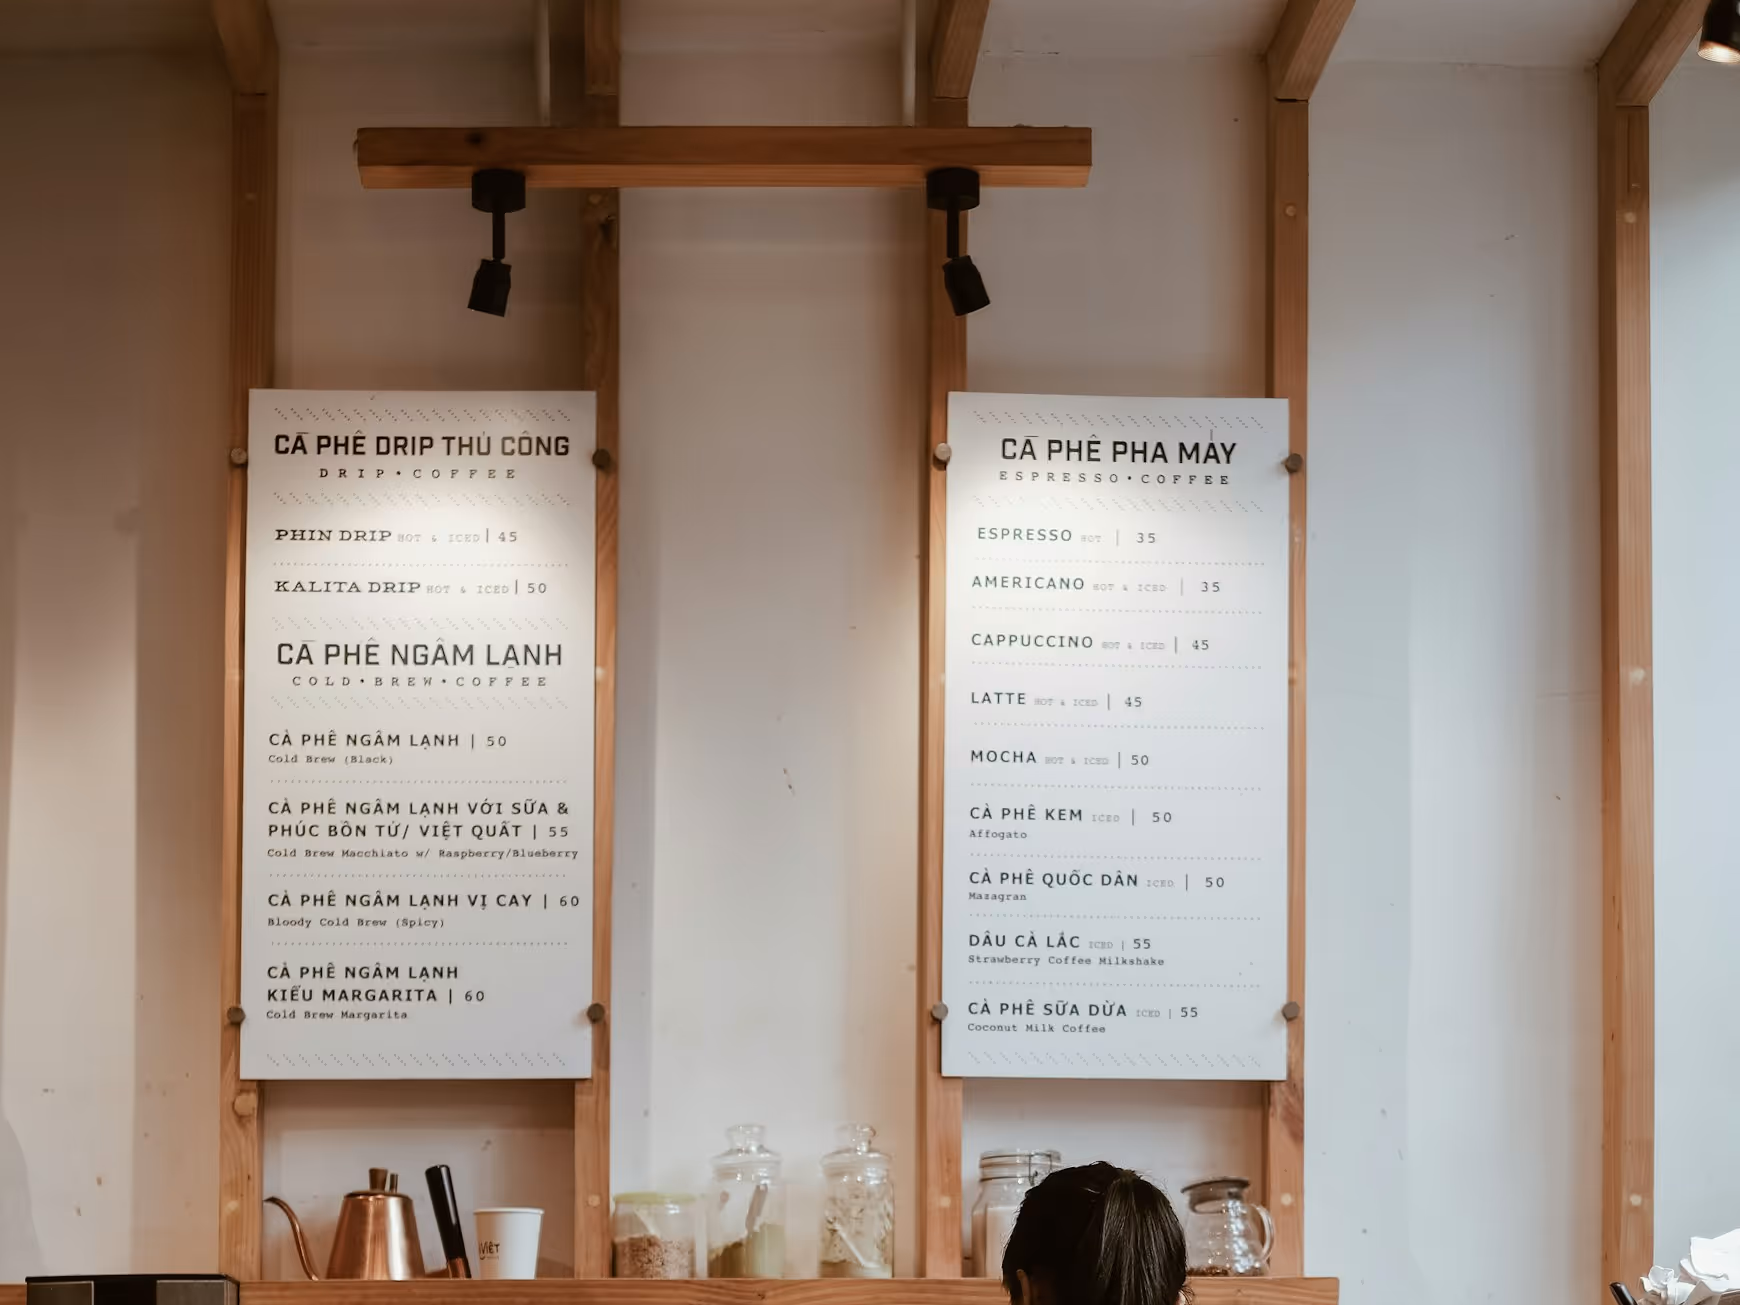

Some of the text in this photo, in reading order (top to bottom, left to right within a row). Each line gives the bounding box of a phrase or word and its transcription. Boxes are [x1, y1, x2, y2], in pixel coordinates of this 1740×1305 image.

[317, 430, 366, 455] PHÊ
[376, 436, 434, 456] DRIP
[501, 431, 569, 456] CÔNG
[1048, 434, 1101, 462] PHÊ
[1113, 441, 1168, 463] PHA
[275, 529, 332, 541] PHIN
[339, 530, 391, 541] DRIP
[498, 532, 517, 542] 45
[978, 528, 1072, 541] ESPRESSO
[1136, 533, 1155, 543] 35
[275, 581, 362, 592] KALITA
[368, 582, 420, 593] DRIP
[528, 583, 546, 593] 50
[972, 576, 1084, 590] AMERICANO
[1201, 581, 1220, 592] 35
[971, 633, 1092, 648] CAPPUCCINO
[1192, 640, 1209, 650] 45
[325, 637, 380, 665] PHÊ
[392, 638, 474, 666] NGÂM
[972, 692, 1025, 704] LATTE
[1125, 697, 1142, 707] 45
[302, 730, 337, 746] PHÊ
[346, 730, 400, 746] NGÂM
[487, 736, 506, 746] 50
[268, 754, 393, 765] Cold Brew (Black)
[971, 750, 1036, 763] MOCHA
[1131, 755, 1149, 766] 50
[301, 798, 336, 814] PHÊ
[346, 798, 399, 815] NGÂM
[468, 798, 502, 815] VỚI
[1002, 804, 1035, 820] PHÊ
[1045, 808, 1082, 821] KEM
[1153, 812, 1172, 823] 50
[269, 820, 319, 837] PHÚC
[419, 821, 463, 840] VIỆT
[549, 826, 568, 837] 55
[969, 829, 1027, 840] Affogato
[267, 848, 296, 857] Cold
[304, 849, 335, 857] Brew
[342, 849, 408, 858] Macchiato
[439, 848, 578, 860] Raspberry/Blueberry
[1000, 868, 1034, 885] PHÊ
[1101, 870, 1137, 887] DÂN
[1206, 877, 1224, 888] 50
[301, 890, 336, 906] PHÊ
[346, 890, 399, 907] NGÂM
[496, 894, 532, 907] CAY
[560, 896, 579, 907] 60
[969, 892, 1027, 902] Mazagran
[268, 917, 443, 928] Bloody Cold Brew (Spicy)
[969, 930, 1005, 947] DÂU
[1133, 938, 1150, 949] 55
[968, 955, 1164, 967] Strawberry Coffee Milkshake
[300, 962, 335, 979] PHÊ
[345, 962, 399, 979] NGÂM
[322, 989, 437, 1002] MARGARITA
[465, 990, 484, 1002] 60
[266, 1009, 407, 1021] Cold Brew Margarita
[1000, 999, 1034, 1015] PHÊ
[1181, 1007, 1198, 1018] 55
[968, 1023, 1106, 1033] Coconut Milk Coffee
